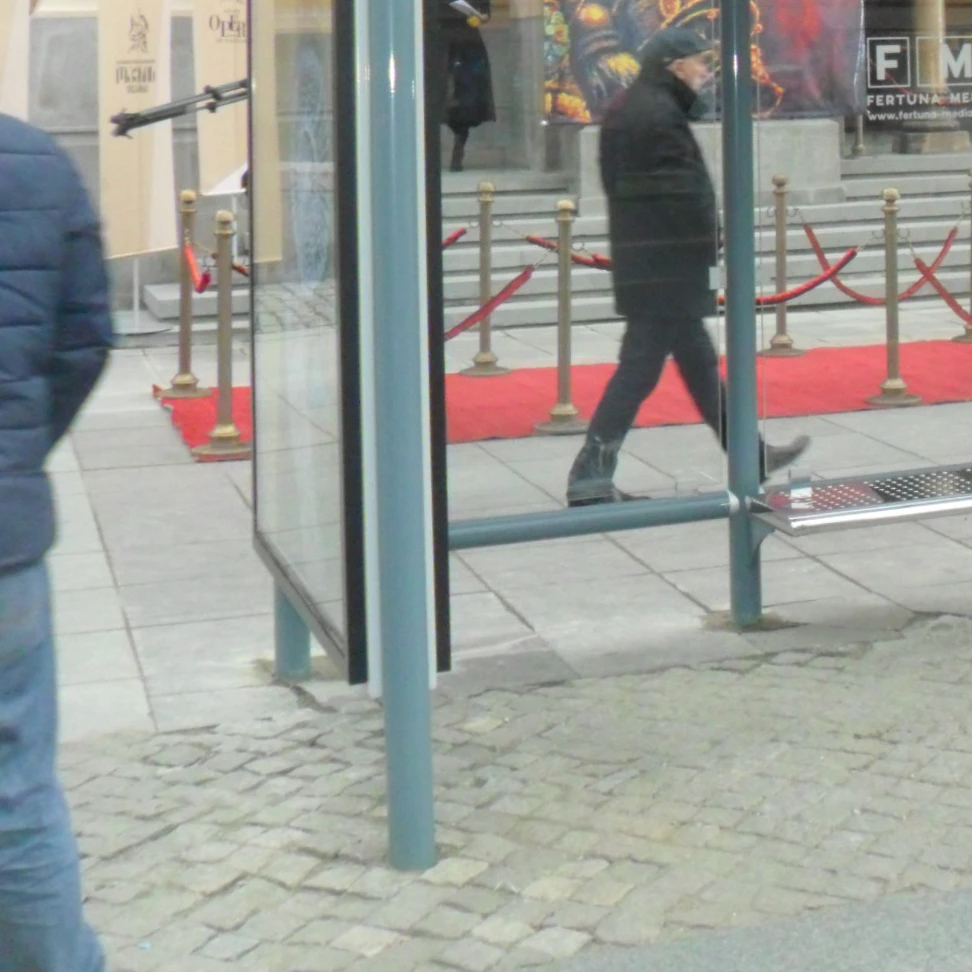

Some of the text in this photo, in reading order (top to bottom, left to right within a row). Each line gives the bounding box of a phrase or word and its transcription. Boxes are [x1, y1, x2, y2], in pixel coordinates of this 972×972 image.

[876, 43, 972, 80] F M
[867, 94, 941, 107] FERTUNA
